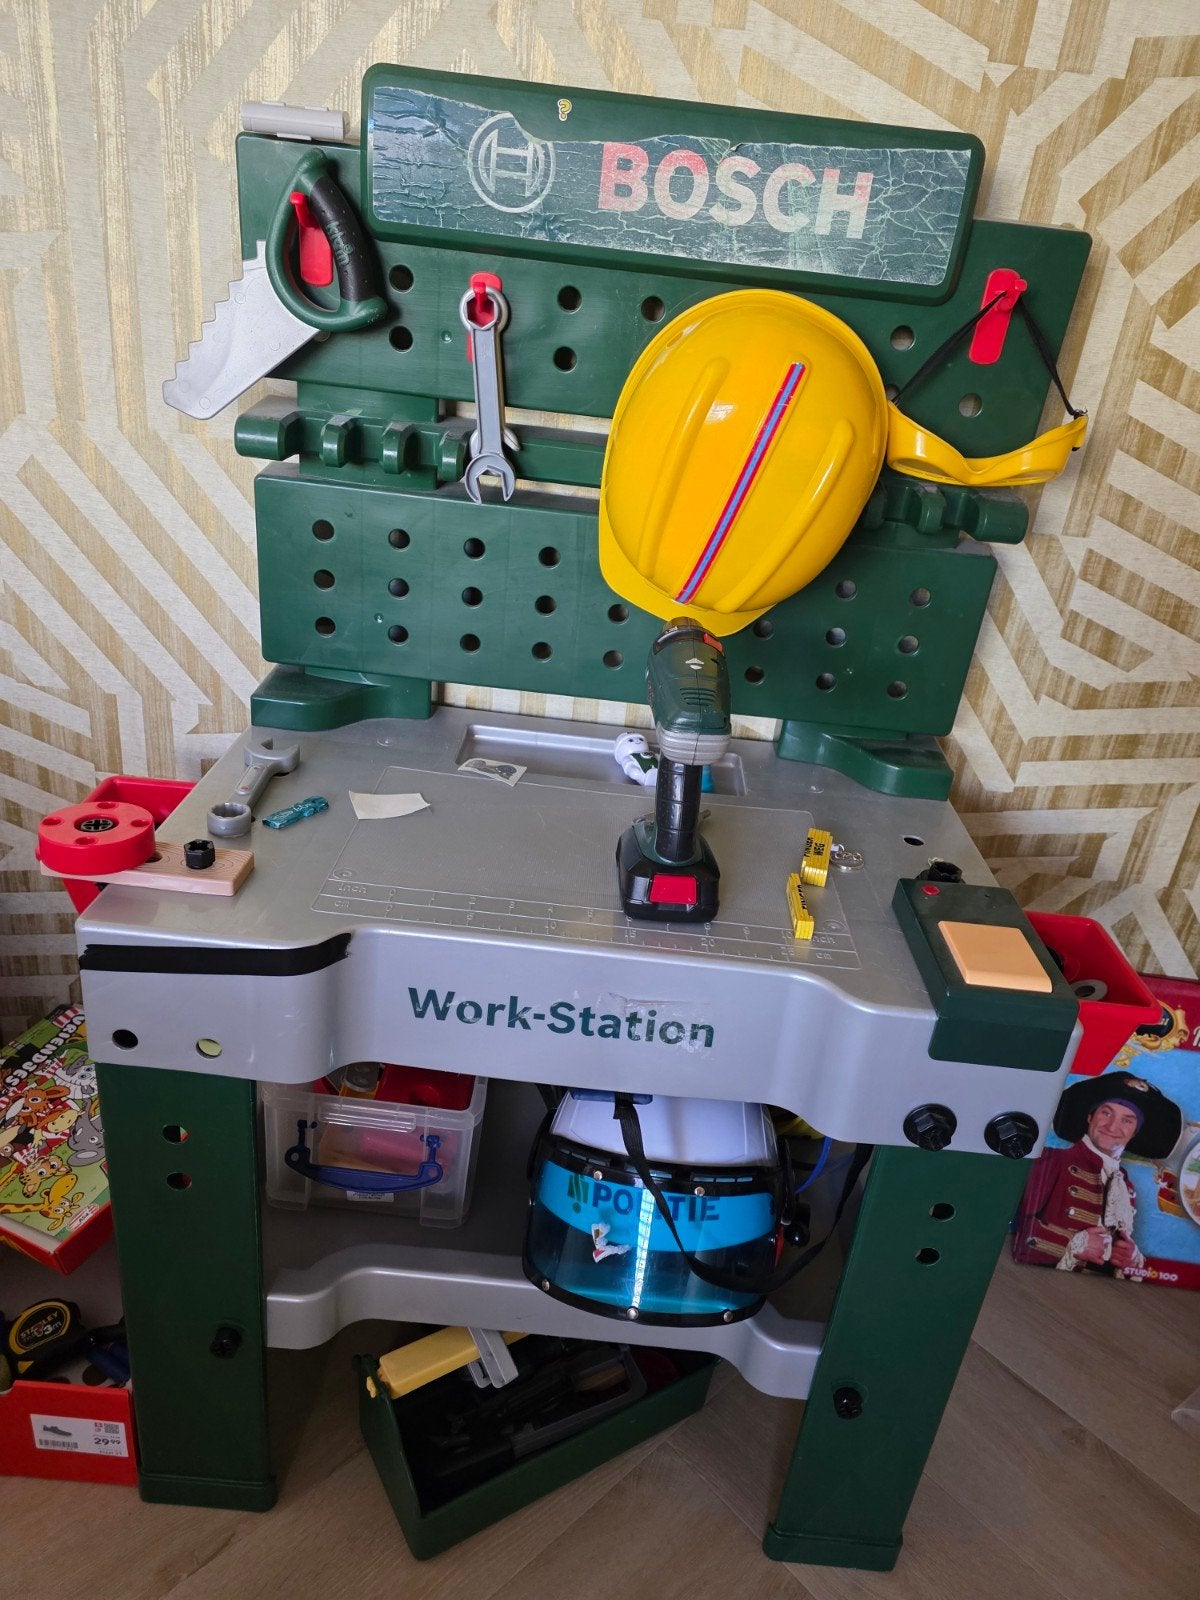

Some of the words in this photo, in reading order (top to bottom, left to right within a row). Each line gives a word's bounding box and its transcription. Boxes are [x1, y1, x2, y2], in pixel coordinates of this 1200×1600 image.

[598, 142, 874, 240] BOSCH
[5, 1013, 86, 1088] VRIENDJES
[408, 986, 716, 1049] Work-Station
[1160, 1272, 1178, 1282] 100
